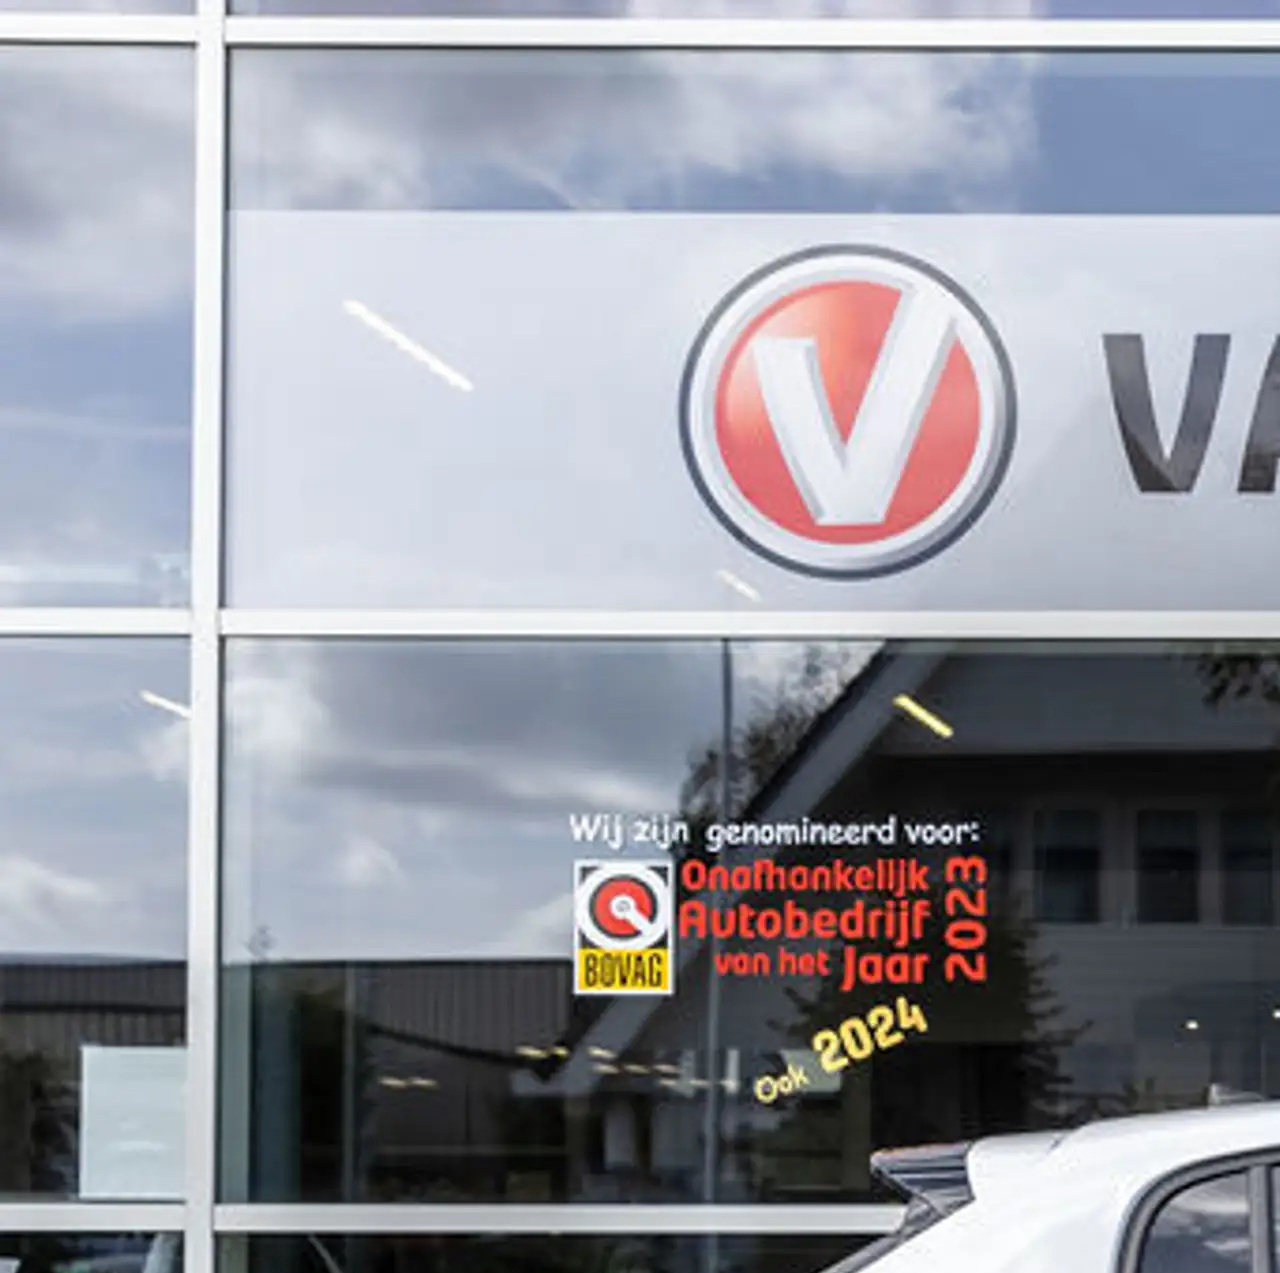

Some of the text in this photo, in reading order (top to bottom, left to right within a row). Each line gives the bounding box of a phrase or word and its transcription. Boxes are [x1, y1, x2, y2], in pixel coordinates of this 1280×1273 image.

[569, 813, 981, 852] Wij zijn genomineerd voor:
[681, 858, 930, 897] Onafhankelijk
[679, 900, 931, 948] Autobedrijf
[944, 855, 987, 982] 2023
[584, 952, 663, 988] BOVAG
[714, 951, 771, 976] van
[779, 947, 832, 976] het
[755, 995, 929, 1103] Ook 2024
